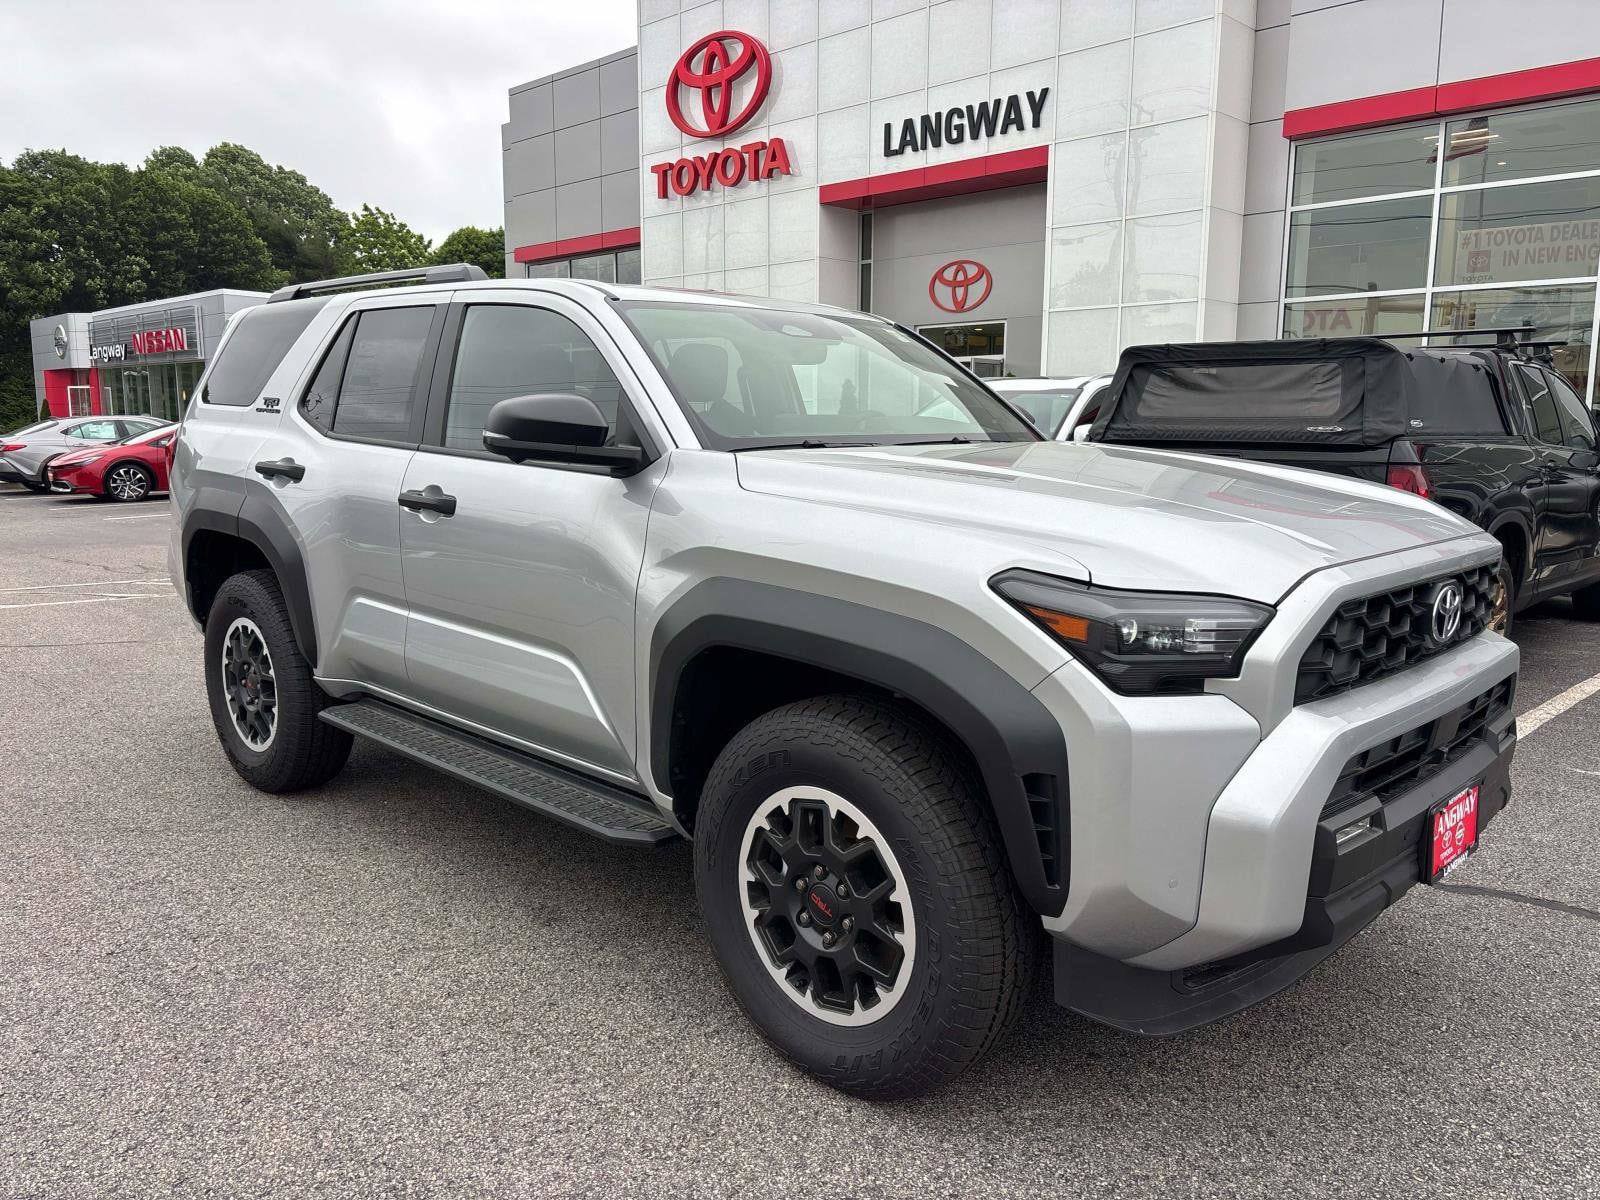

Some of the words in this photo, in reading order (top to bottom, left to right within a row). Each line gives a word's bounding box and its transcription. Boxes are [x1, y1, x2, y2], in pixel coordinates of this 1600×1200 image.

[883, 87, 1049, 157] LANGWAY
[651, 137, 791, 199] TOYOTA
[1461, 232, 1481, 250] #1
[1486, 226, 1545, 247] TOYOTA
[1502, 250, 1520, 267] IN
[1524, 247, 1561, 265] NEW
[88, 343, 126, 362] Langway
[132, 327, 187, 354] NISSAN
